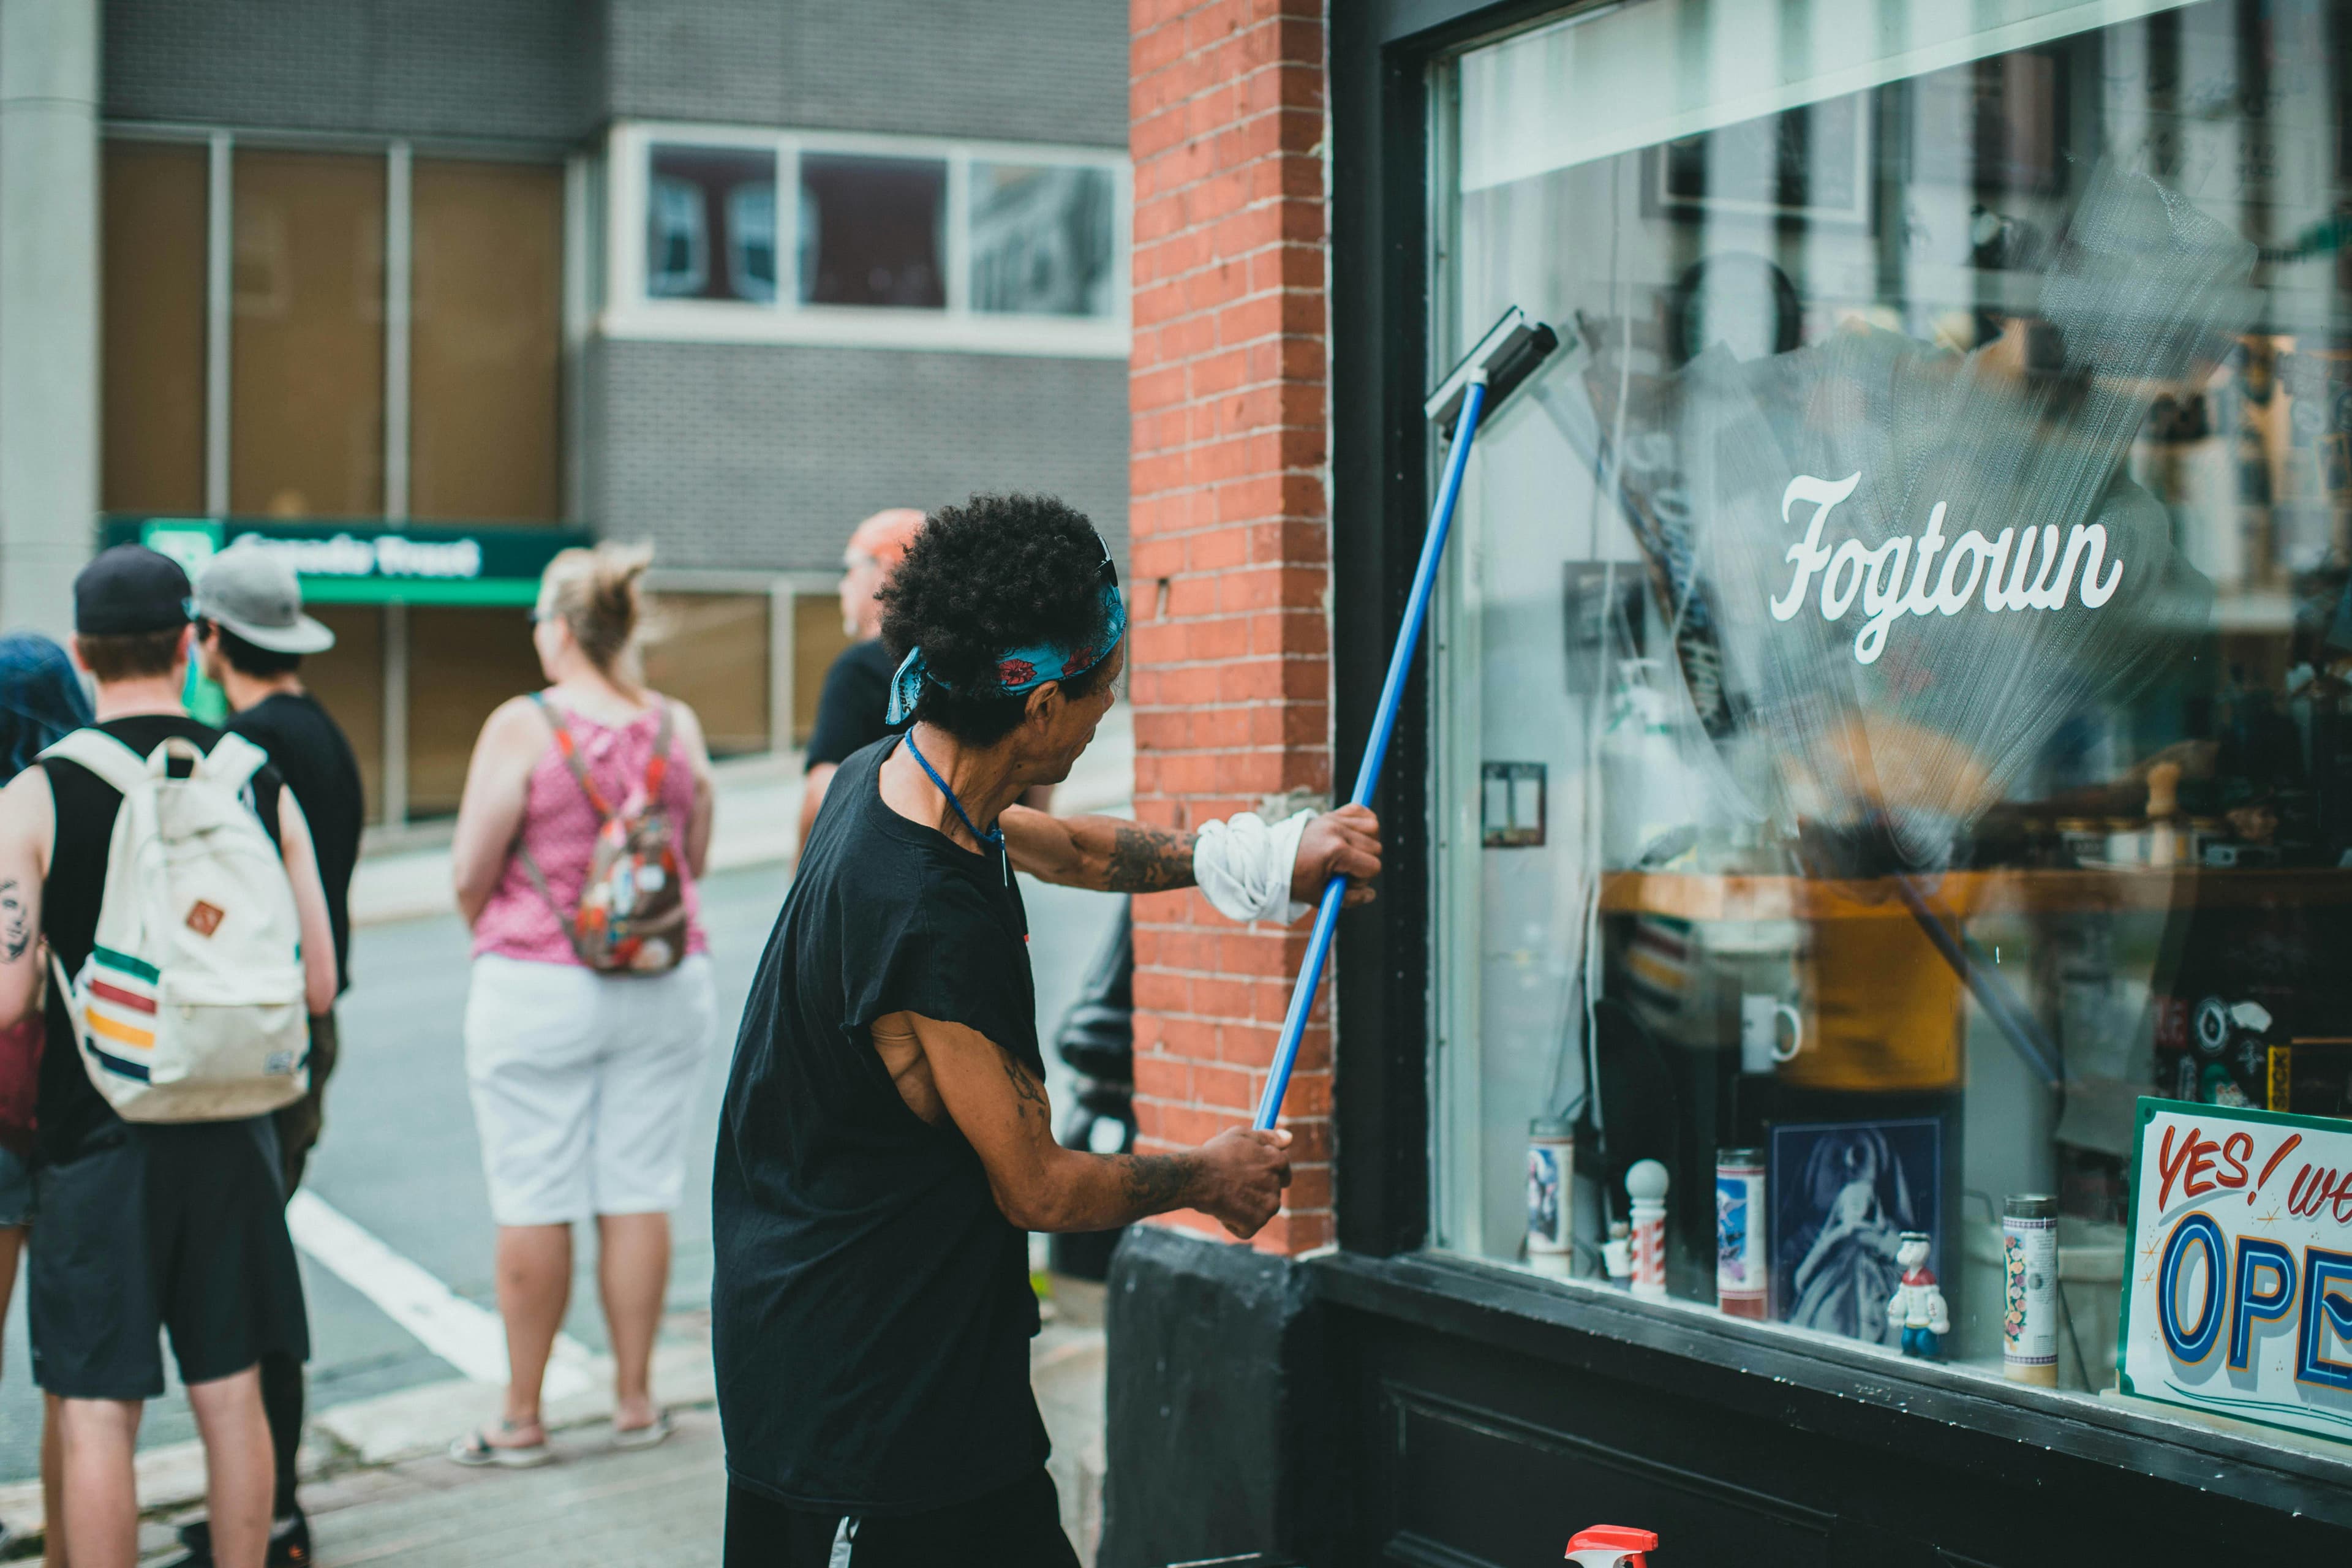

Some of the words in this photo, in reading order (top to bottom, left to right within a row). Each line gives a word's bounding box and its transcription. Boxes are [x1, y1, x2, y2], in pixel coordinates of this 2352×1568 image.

[1771, 471, 2124, 665] Fogtown
[2158, 1125, 2302, 1213] YES!
[2157, 1210, 2352, 1393] OPE
